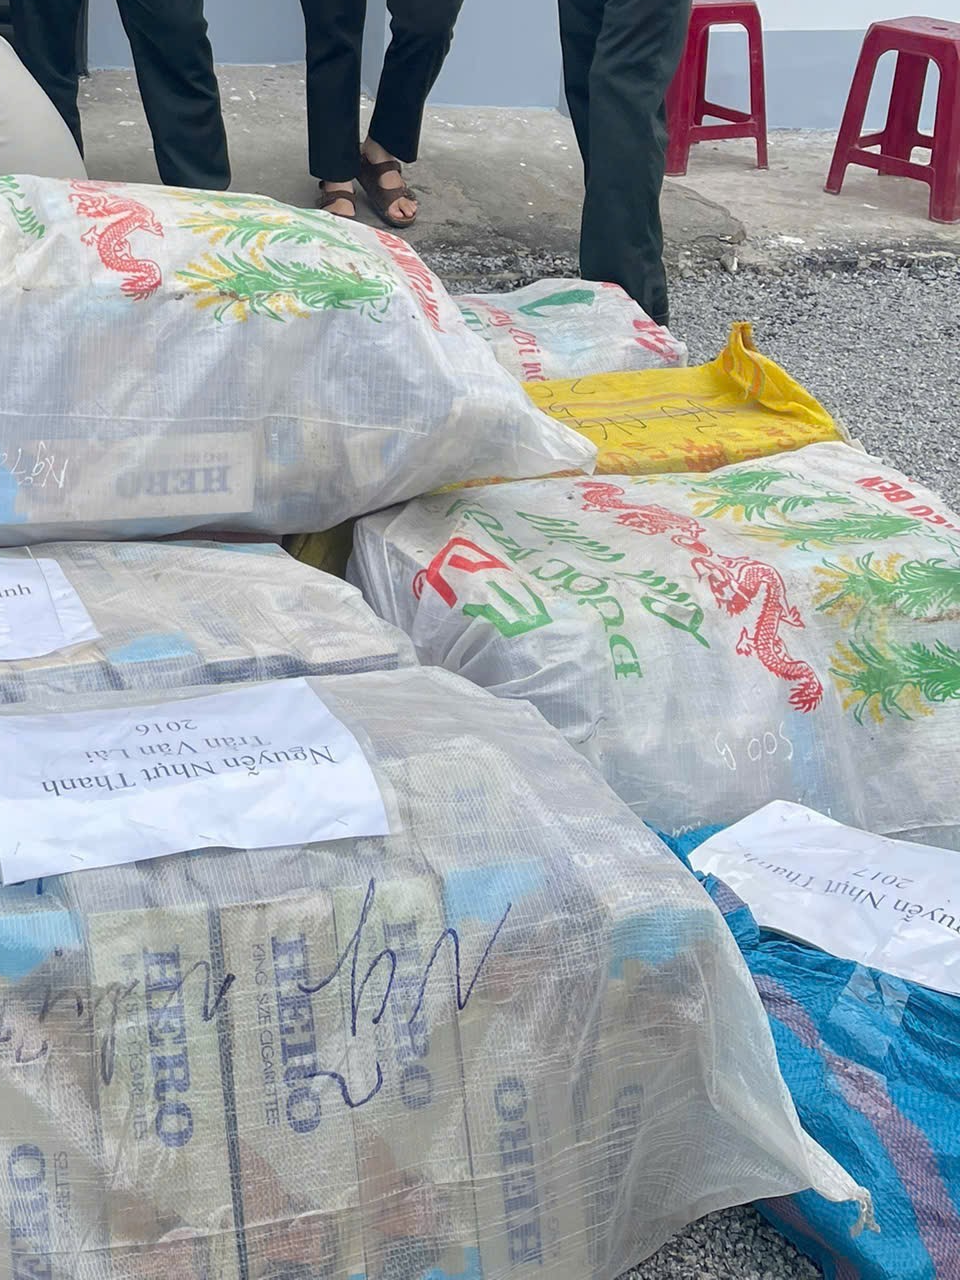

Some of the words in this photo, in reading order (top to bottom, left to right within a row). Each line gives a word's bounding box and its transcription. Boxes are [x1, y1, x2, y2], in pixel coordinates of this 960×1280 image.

[135, 719, 198, 735] 2016
[143, 760, 218, 781] Nhựt
[224, 744, 338, 776] Nguyễn
[41, 771, 137, 796] Thanh
[852, 867, 915, 890] 2017
[252, 943, 268, 985] KING
[256, 991, 272, 1027] SIZE
[143, 944, 193, 1148] HERO
[272, 933, 321, 1133] HERO
